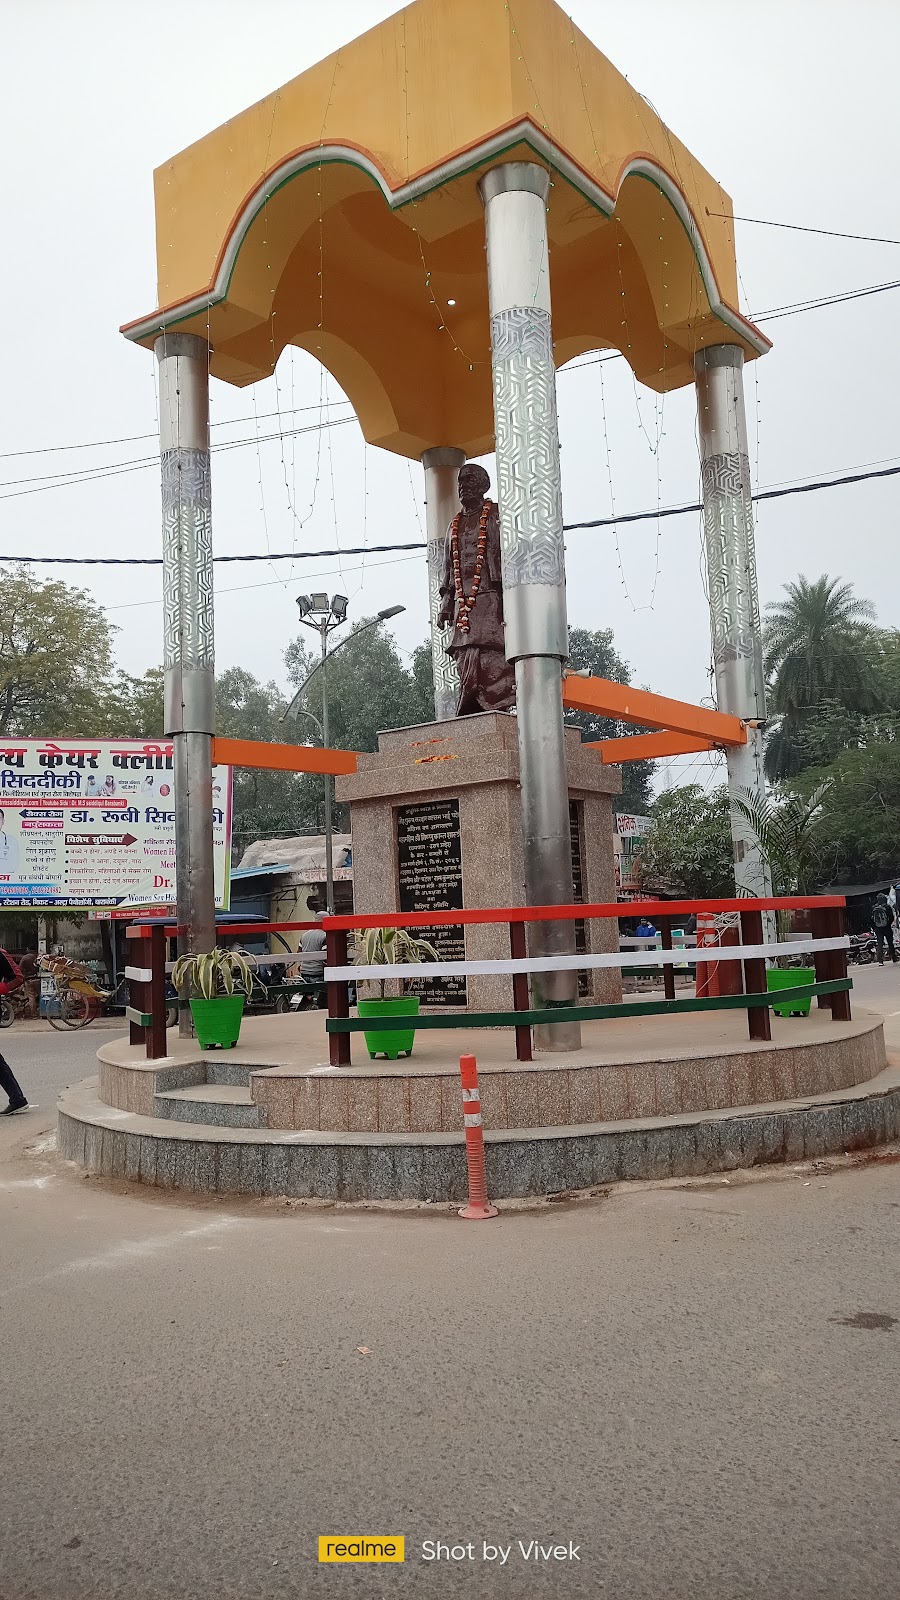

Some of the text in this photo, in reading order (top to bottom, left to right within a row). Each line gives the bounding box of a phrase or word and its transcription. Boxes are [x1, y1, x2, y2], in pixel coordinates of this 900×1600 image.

[36, 743, 101, 769] केयर
[26, 810, 62, 818] सेक्स रोग
[101, 807, 140, 823] रूबी
[66, 835, 89, 843] विशेष
[160, 860, 176, 868] Meet
[153, 875, 174, 888] Dr.
[128, 894, 153, 902] Women
